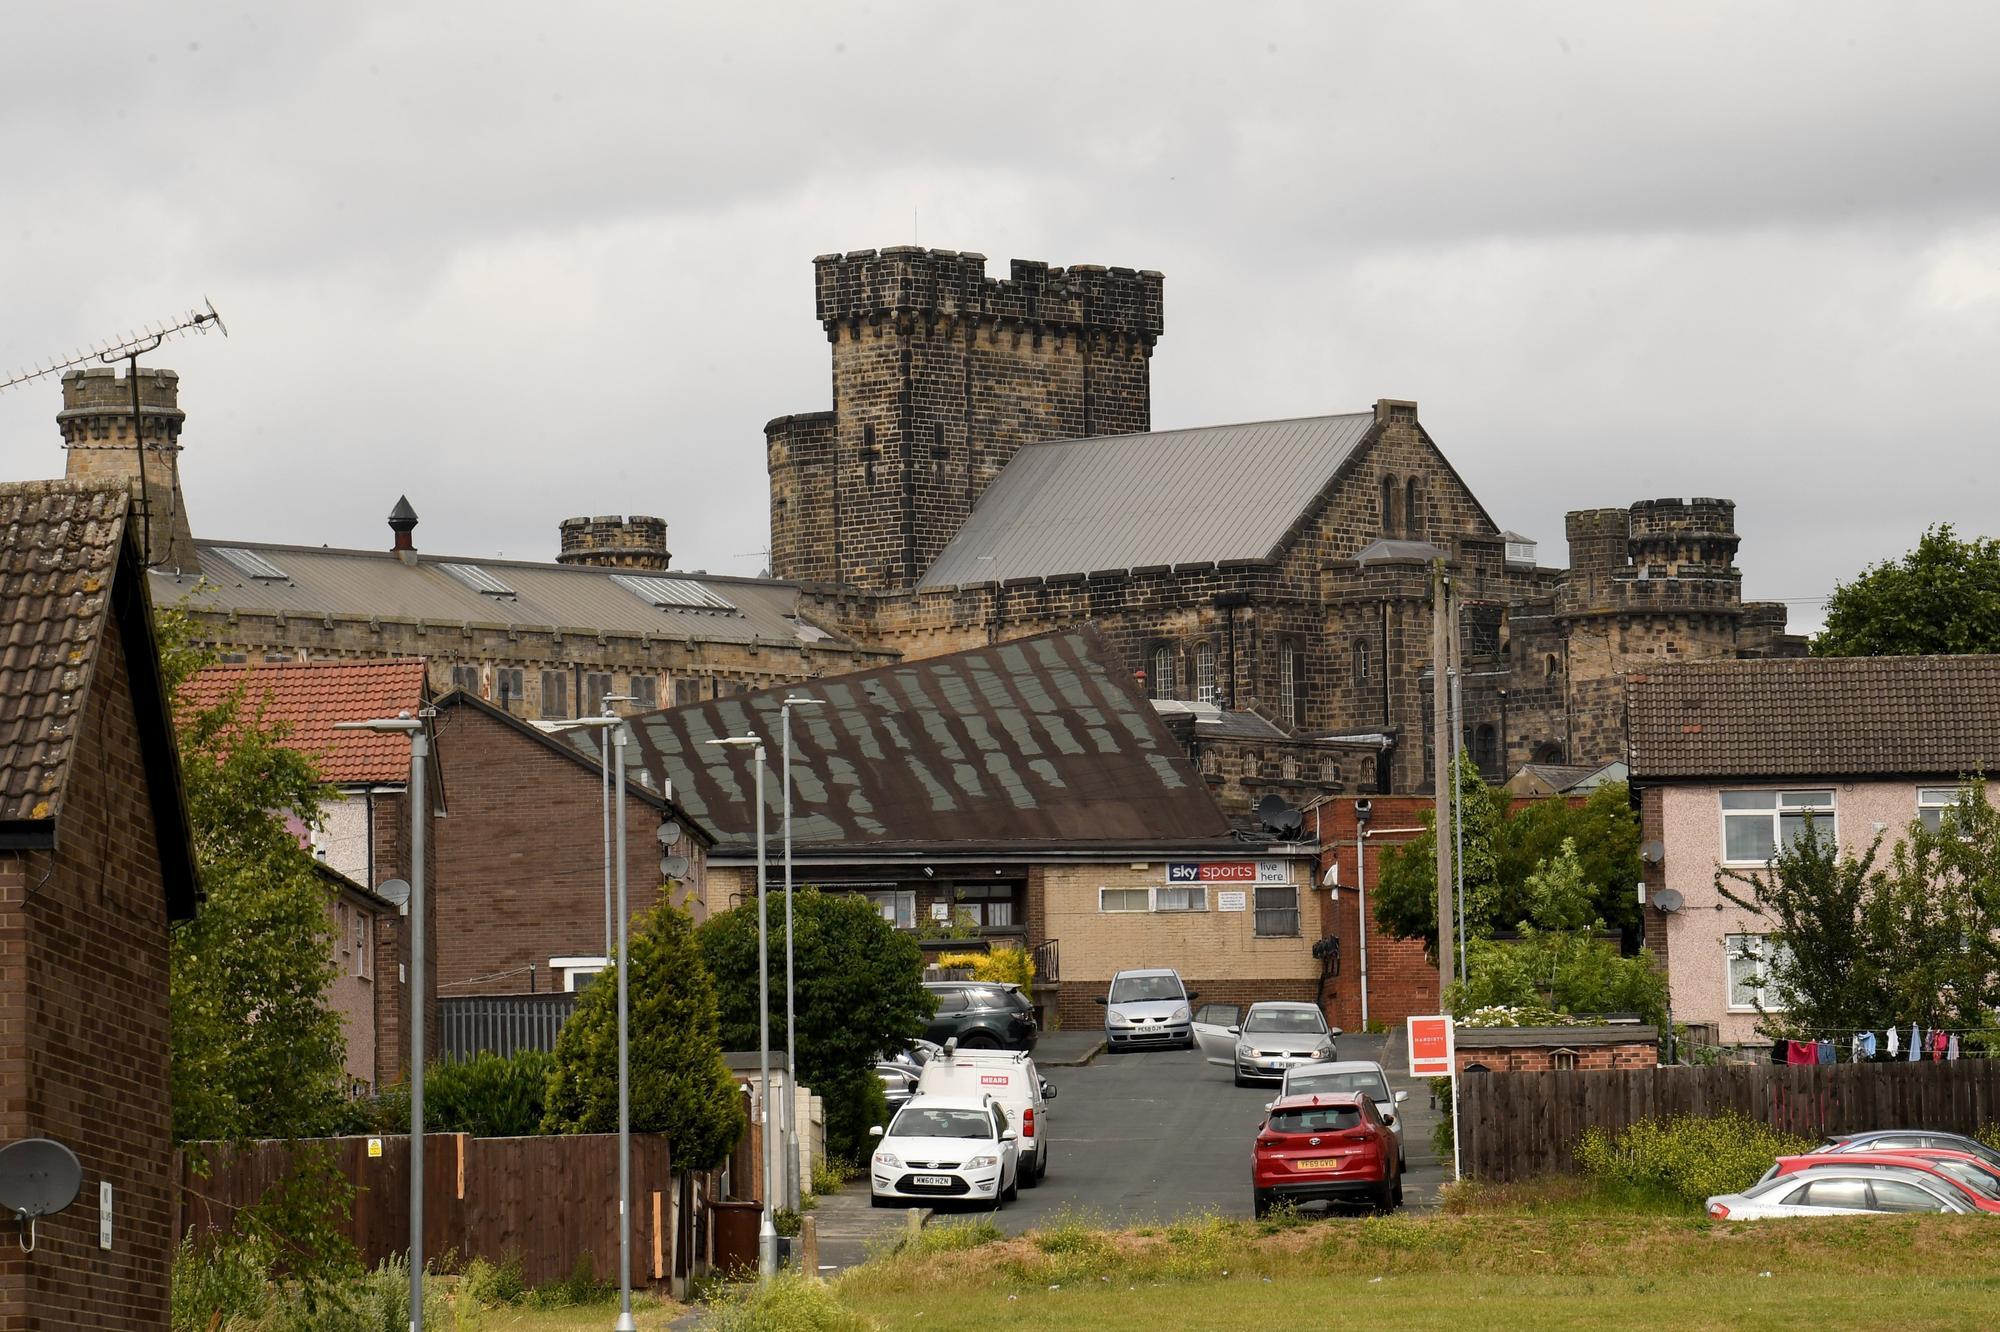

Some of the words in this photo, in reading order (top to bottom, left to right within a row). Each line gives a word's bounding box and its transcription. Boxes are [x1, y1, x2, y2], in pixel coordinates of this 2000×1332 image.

[1260, 862, 1277, 871] live
[1172, 864, 1197, 880] sky
[1202, 865, 1252, 879] sports
[1260, 872, 1283, 880] here
[935, 1177, 949, 1185] HZN
